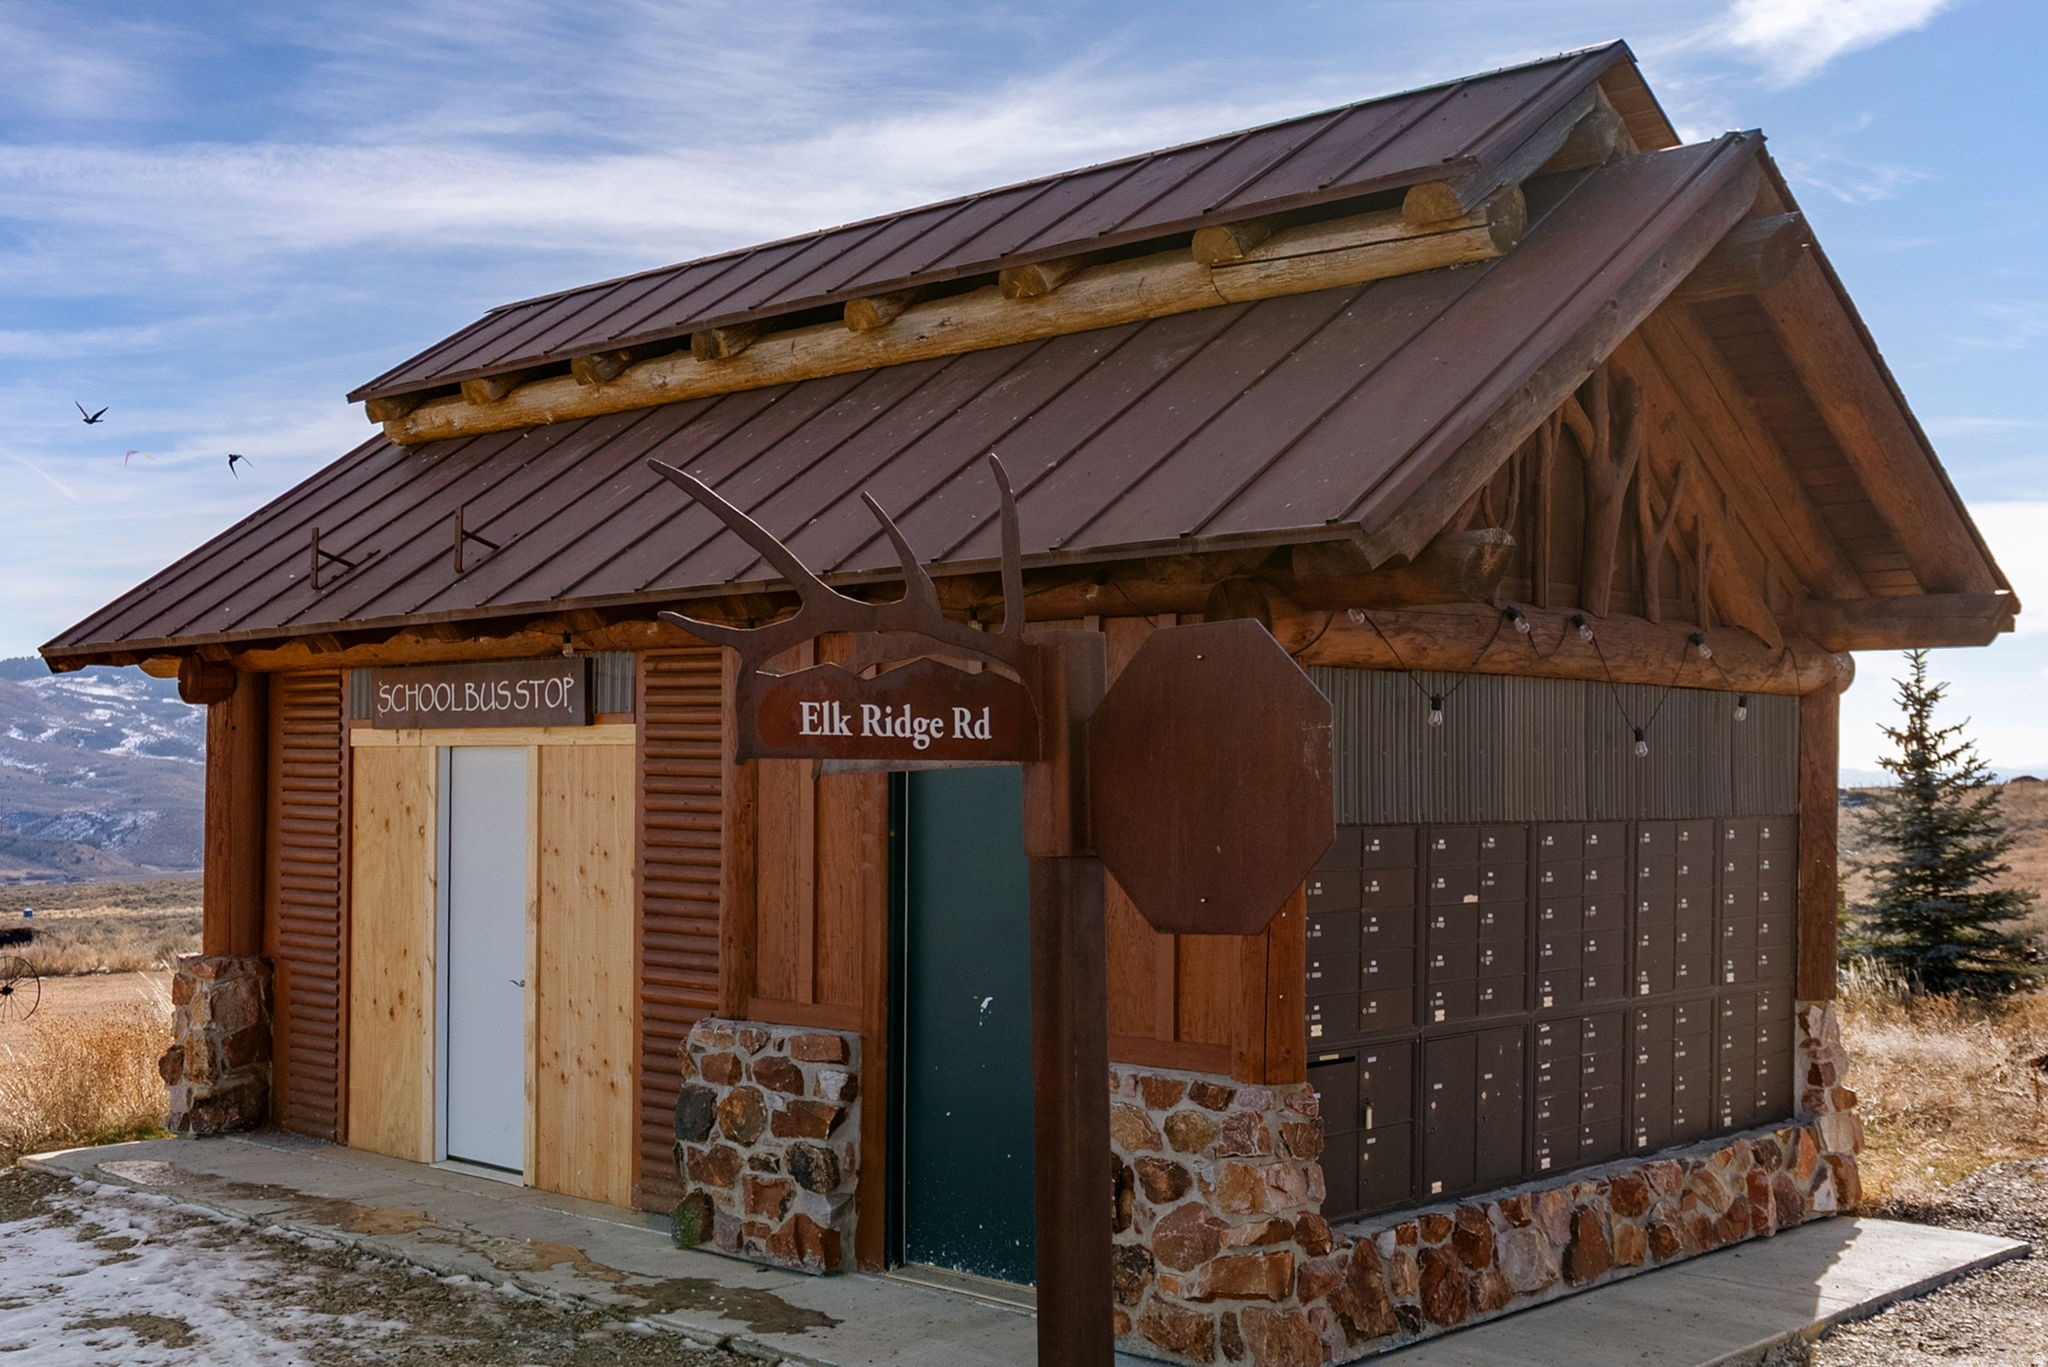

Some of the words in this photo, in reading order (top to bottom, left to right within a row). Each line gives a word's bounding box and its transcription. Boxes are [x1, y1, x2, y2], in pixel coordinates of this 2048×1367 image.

[377, 682, 463, 713] SCHOOL
[464, 680, 511, 712] BUS
[514, 677, 575, 710] STOP
[799, 700, 853, 736] Elk
[860, 703, 944, 750] Ridge
[952, 706, 993, 740] Rd
